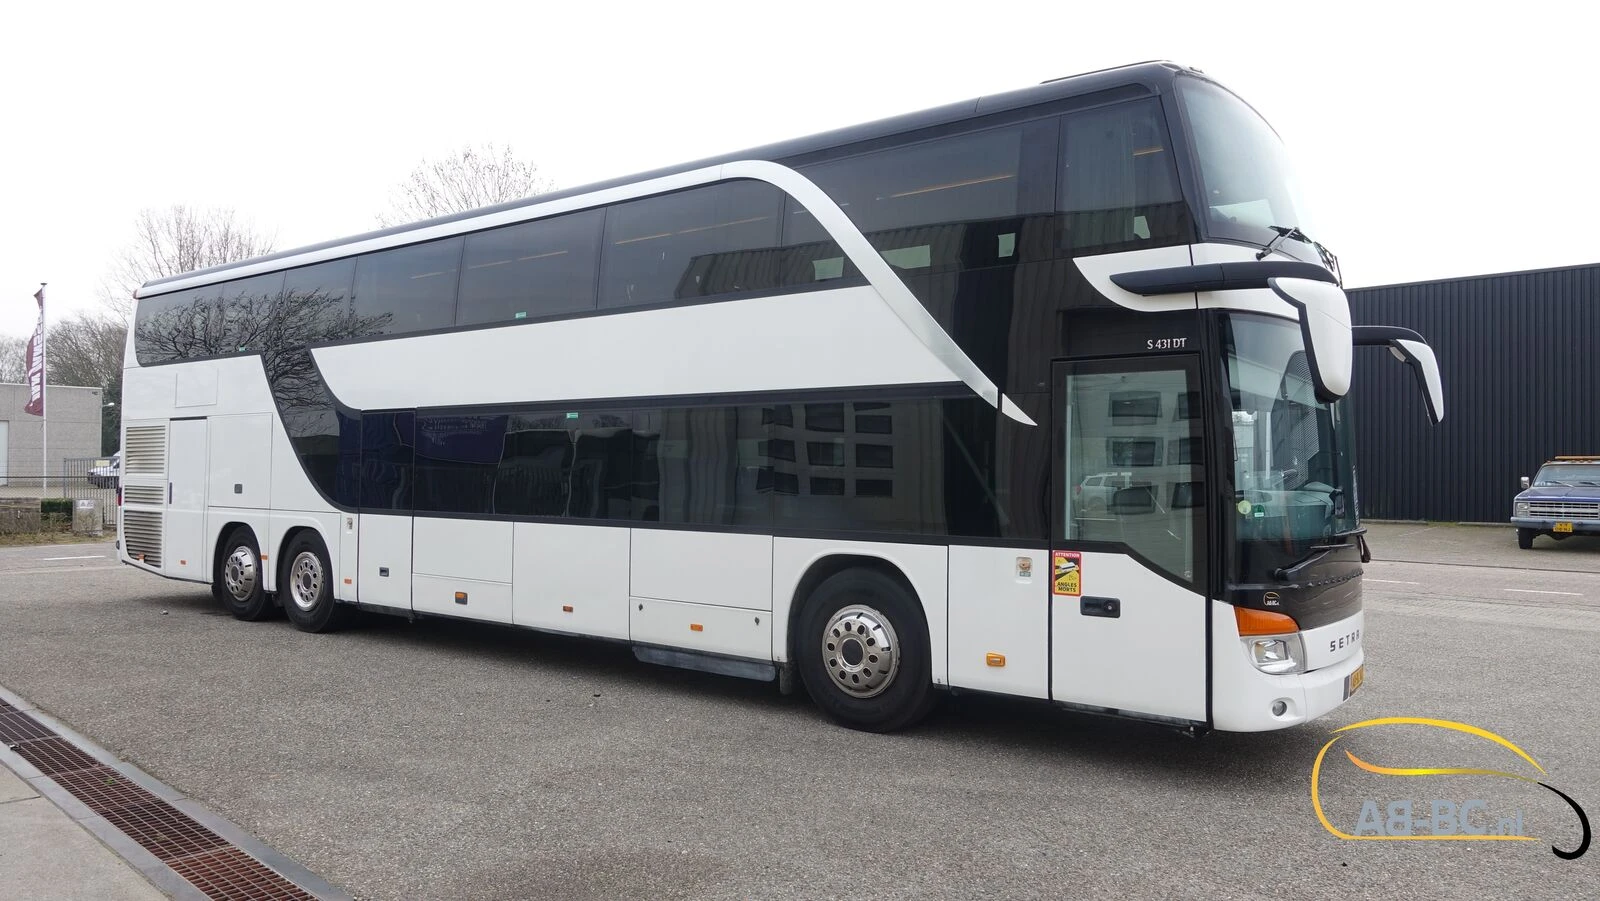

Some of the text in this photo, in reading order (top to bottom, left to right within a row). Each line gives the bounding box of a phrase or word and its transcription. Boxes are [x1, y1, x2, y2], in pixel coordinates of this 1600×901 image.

[1146, 337, 1188, 350] S 431 DT
[1330, 629, 1360, 653] SETRA
